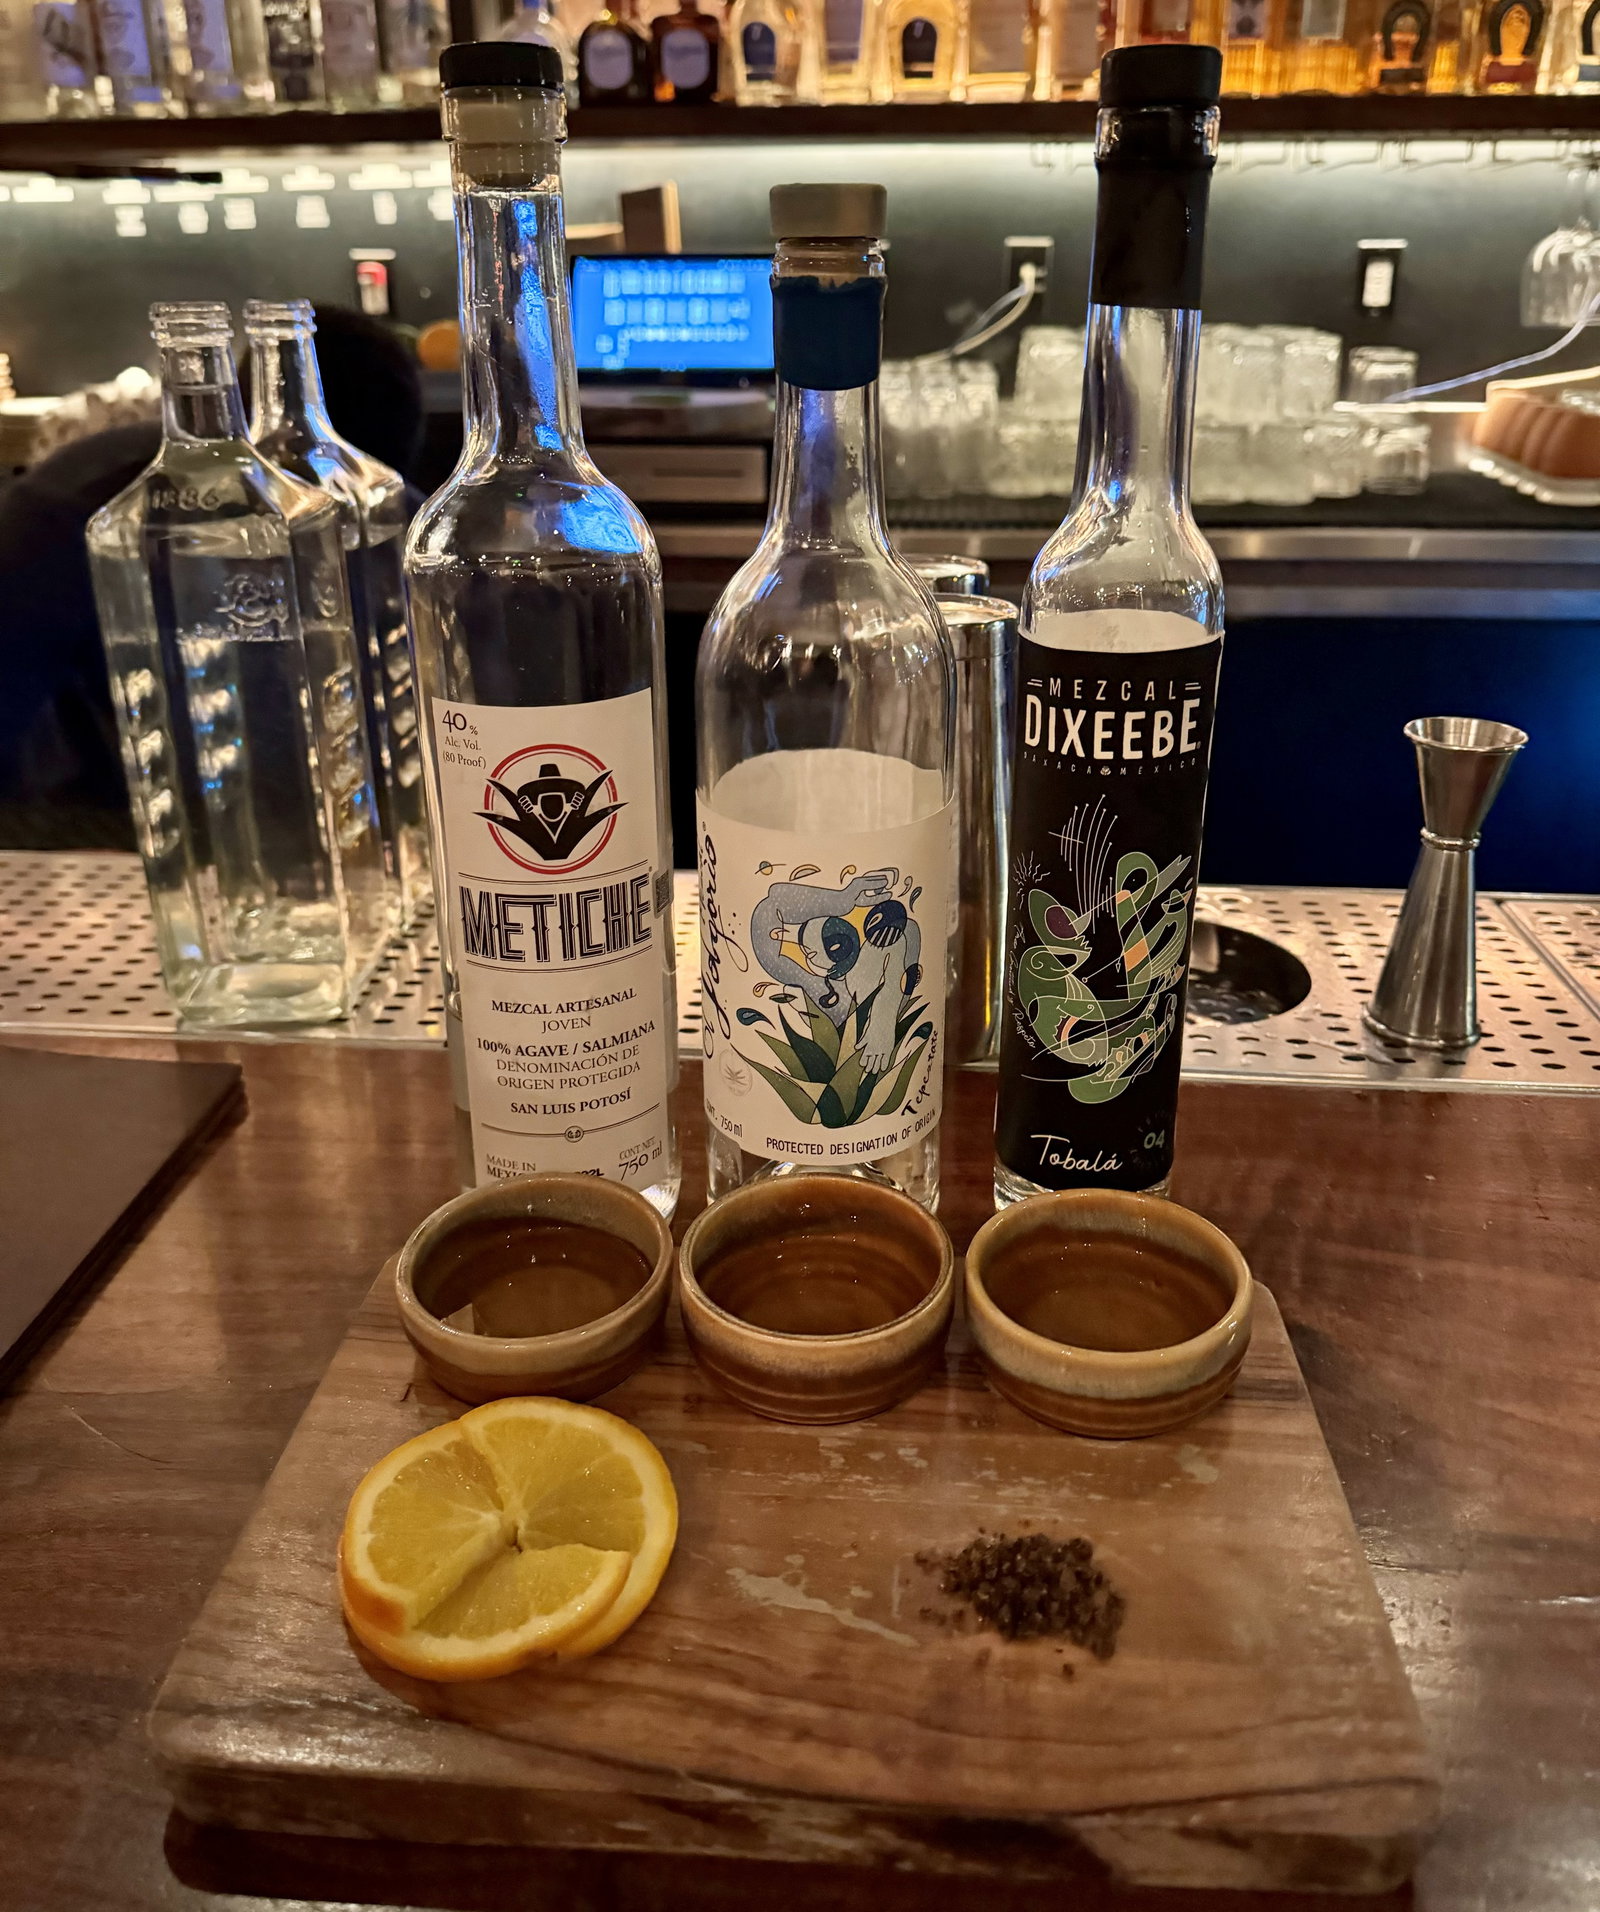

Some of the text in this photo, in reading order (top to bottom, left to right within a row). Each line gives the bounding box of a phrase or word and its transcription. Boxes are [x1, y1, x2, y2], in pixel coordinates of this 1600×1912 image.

[1049, 677, 1176, 701] MEZCAL
[1024, 694, 1200, 760] DIXEEBE
[443, 750, 487, 769] (80 Proof)
[459, 873, 652, 962] METICHE
[491, 988, 637, 1015] MEZCAL ARTESANAL
[477, 1038, 511, 1056] 100%
[515, 1044, 569, 1057] AGAVE
[582, 1020, 655, 1053] SALMIANA
[541, 1016, 591, 1034] JOVEN
[496, 1045, 640, 1074] DENOMINACIÓN DE
[497, 1062, 641, 1090] ORIGEN PROTEGIDA
[511, 1087, 632, 1115] SAN LUIS POTOSÍ
[766, 1108, 936, 1155] PROTECTED DESIGNATION OF ORIGIN
[1143, 1129, 1165, 1149] 04
[486, 1152, 536, 1171] MADE IN
[1030, 1134, 1123, 1172] Tobalá
[618, 1155, 649, 1181] 750
